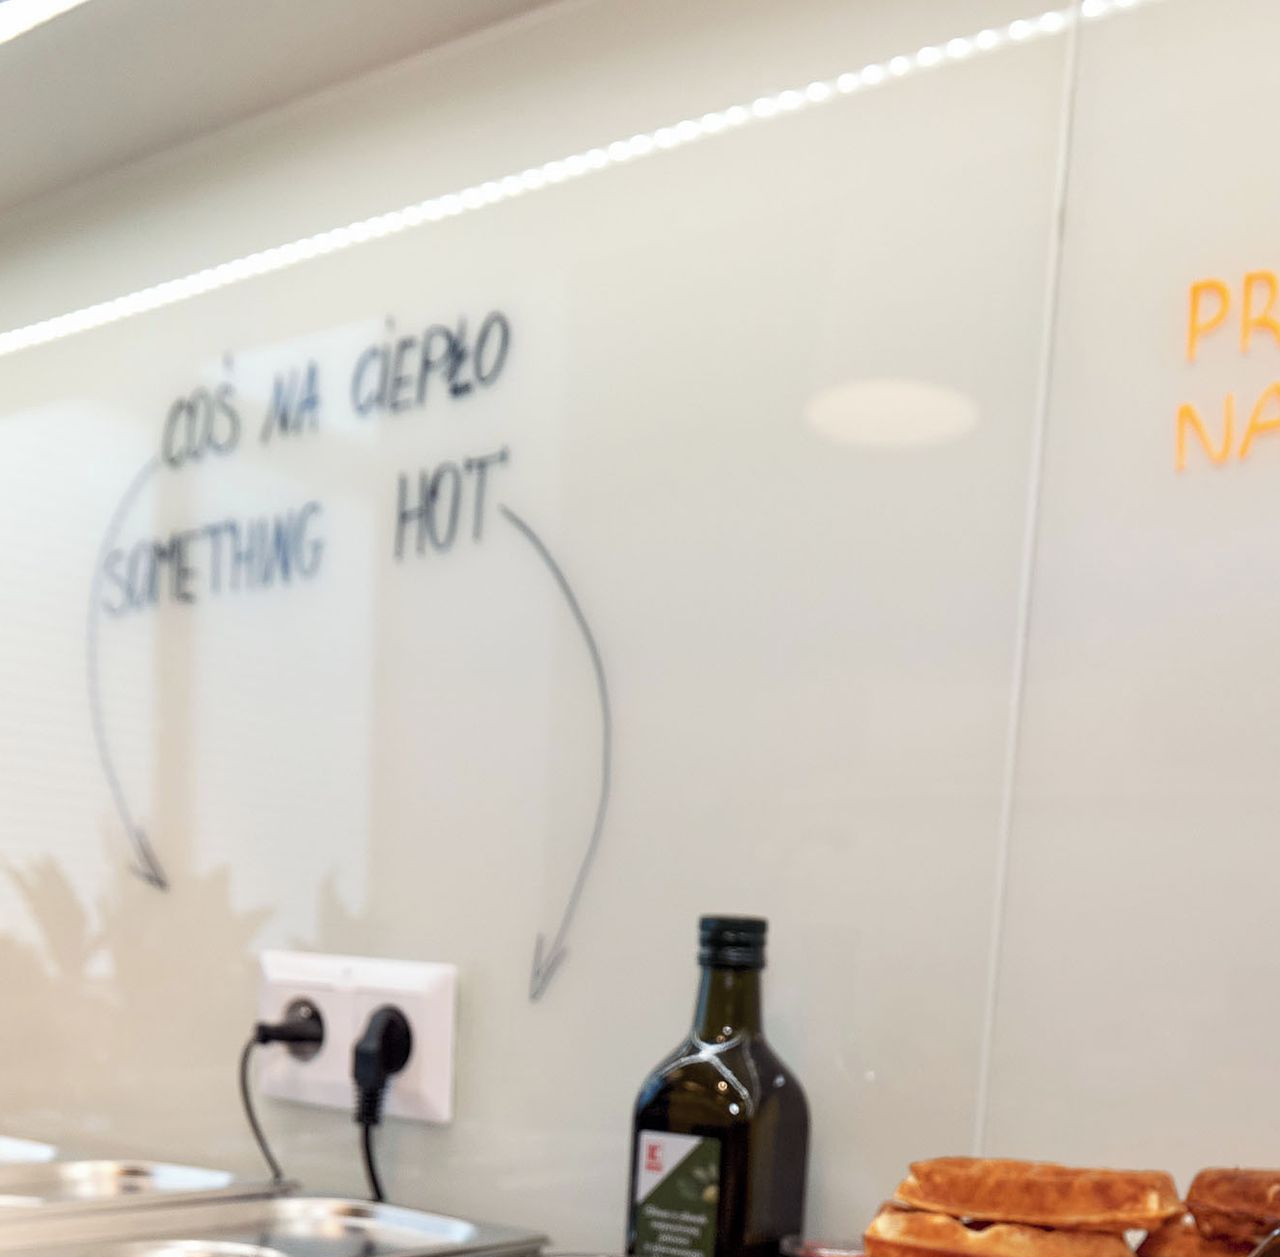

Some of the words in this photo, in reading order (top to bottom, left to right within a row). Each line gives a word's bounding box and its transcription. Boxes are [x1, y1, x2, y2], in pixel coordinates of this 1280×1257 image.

[260, 359, 320, 445] NA
[101, 500, 325, 618] SOMETHING
[393, 444, 511, 563] HOT
